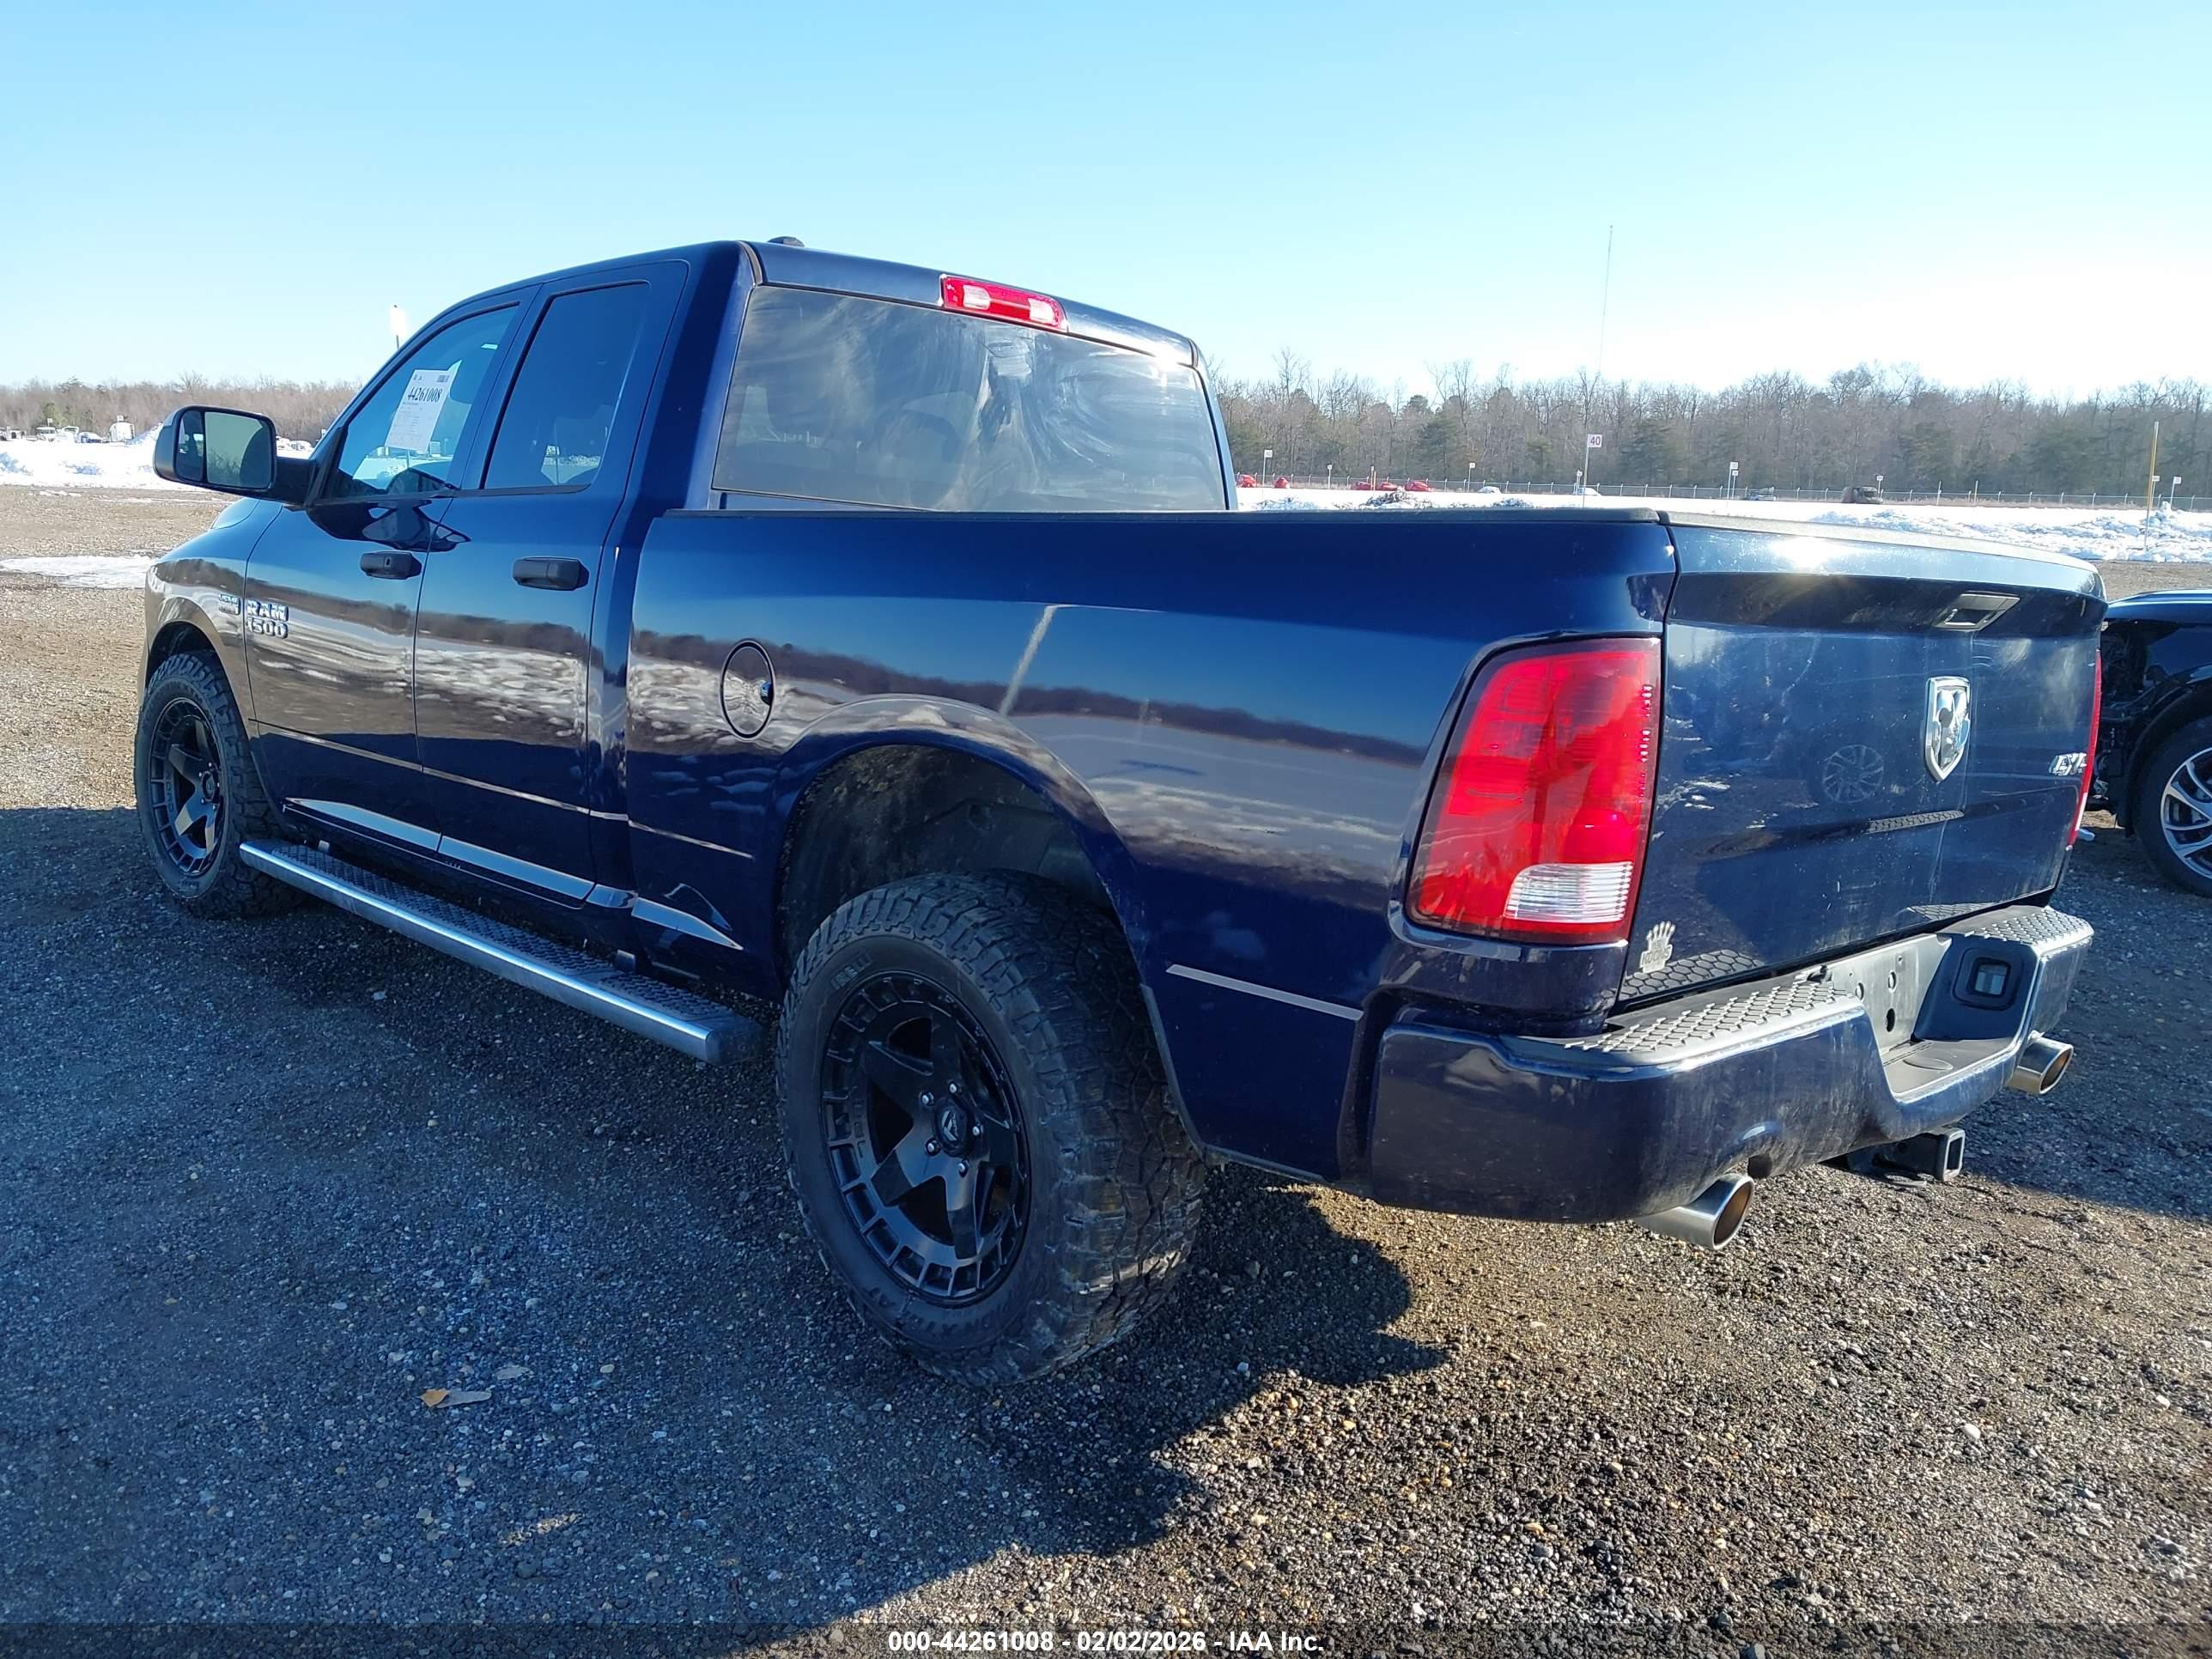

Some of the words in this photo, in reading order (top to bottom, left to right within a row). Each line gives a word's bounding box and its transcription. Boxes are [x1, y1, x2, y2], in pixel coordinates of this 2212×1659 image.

[407, 386, 443, 403] 44261008
[1590, 436, 1601, 446] 40
[246, 599, 289, 622] RAM
[246, 617, 289, 639] 1500
